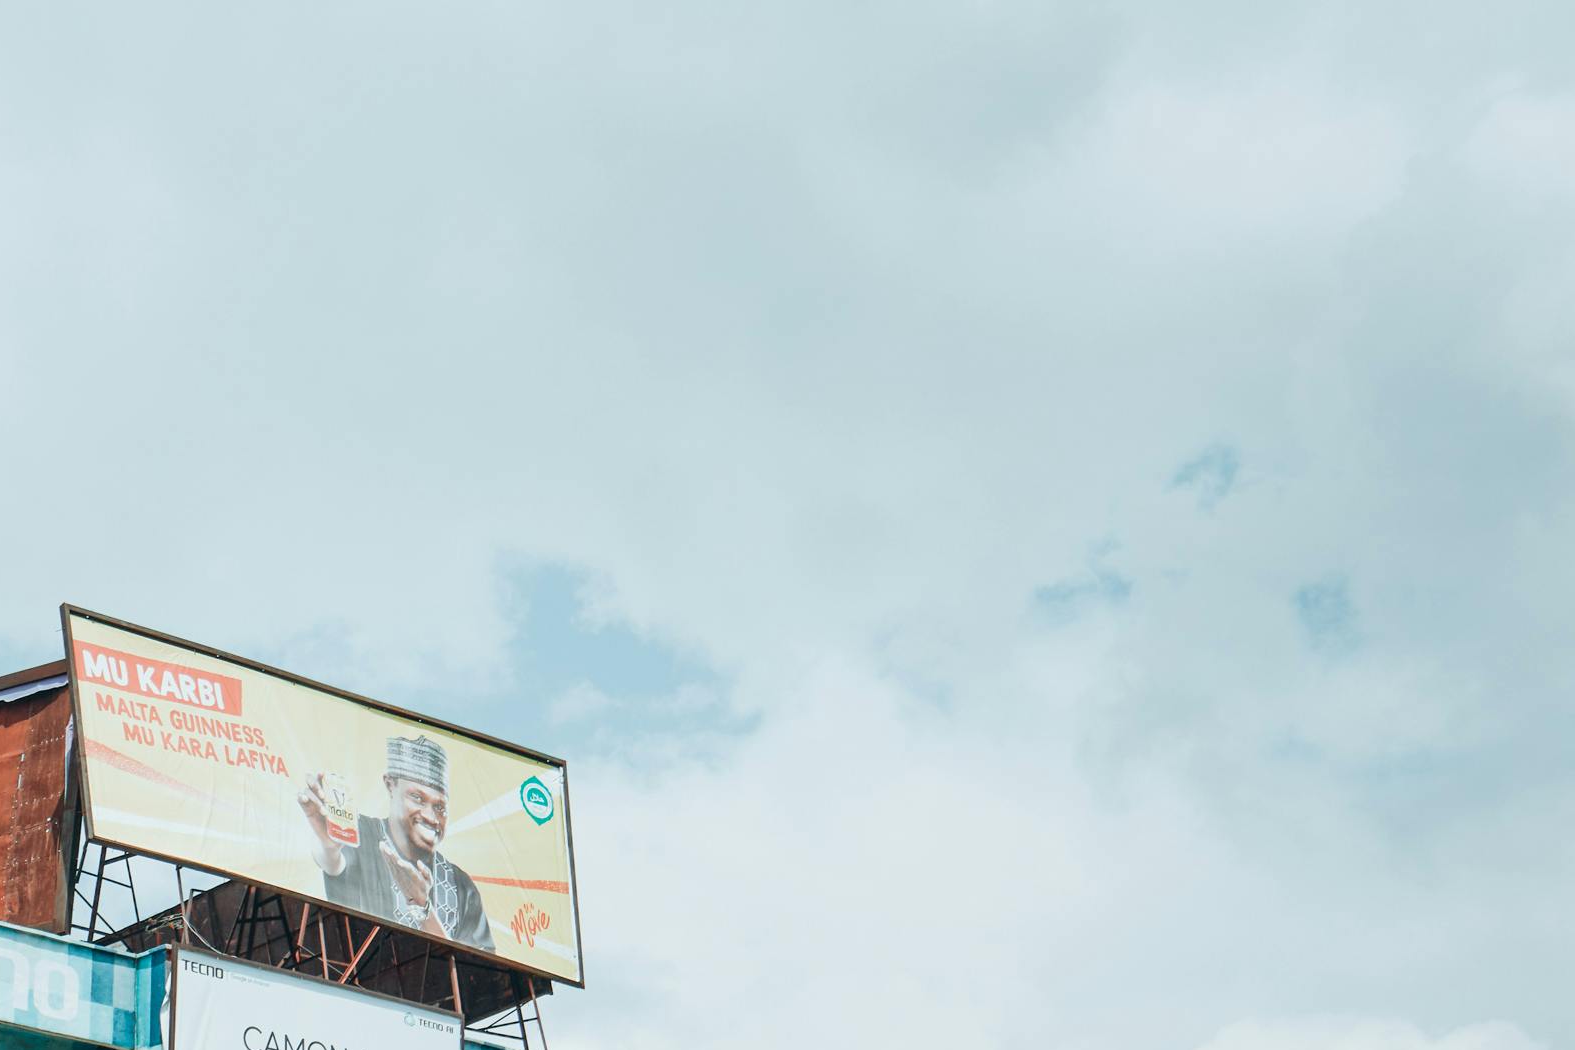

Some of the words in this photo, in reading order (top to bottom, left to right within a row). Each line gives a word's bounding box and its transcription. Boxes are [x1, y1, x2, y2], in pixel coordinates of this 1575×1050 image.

[82, 650, 129, 687] MU
[136, 663, 225, 711] KARBI
[95, 691, 162, 727] MALTA
[123, 721, 155, 747] MU
[161, 730, 219, 763] KARA
[225, 744, 289, 778] LAFIYA
[181, 958, 224, 980] TECNO
[419, 1018, 444, 1032] TECNO
